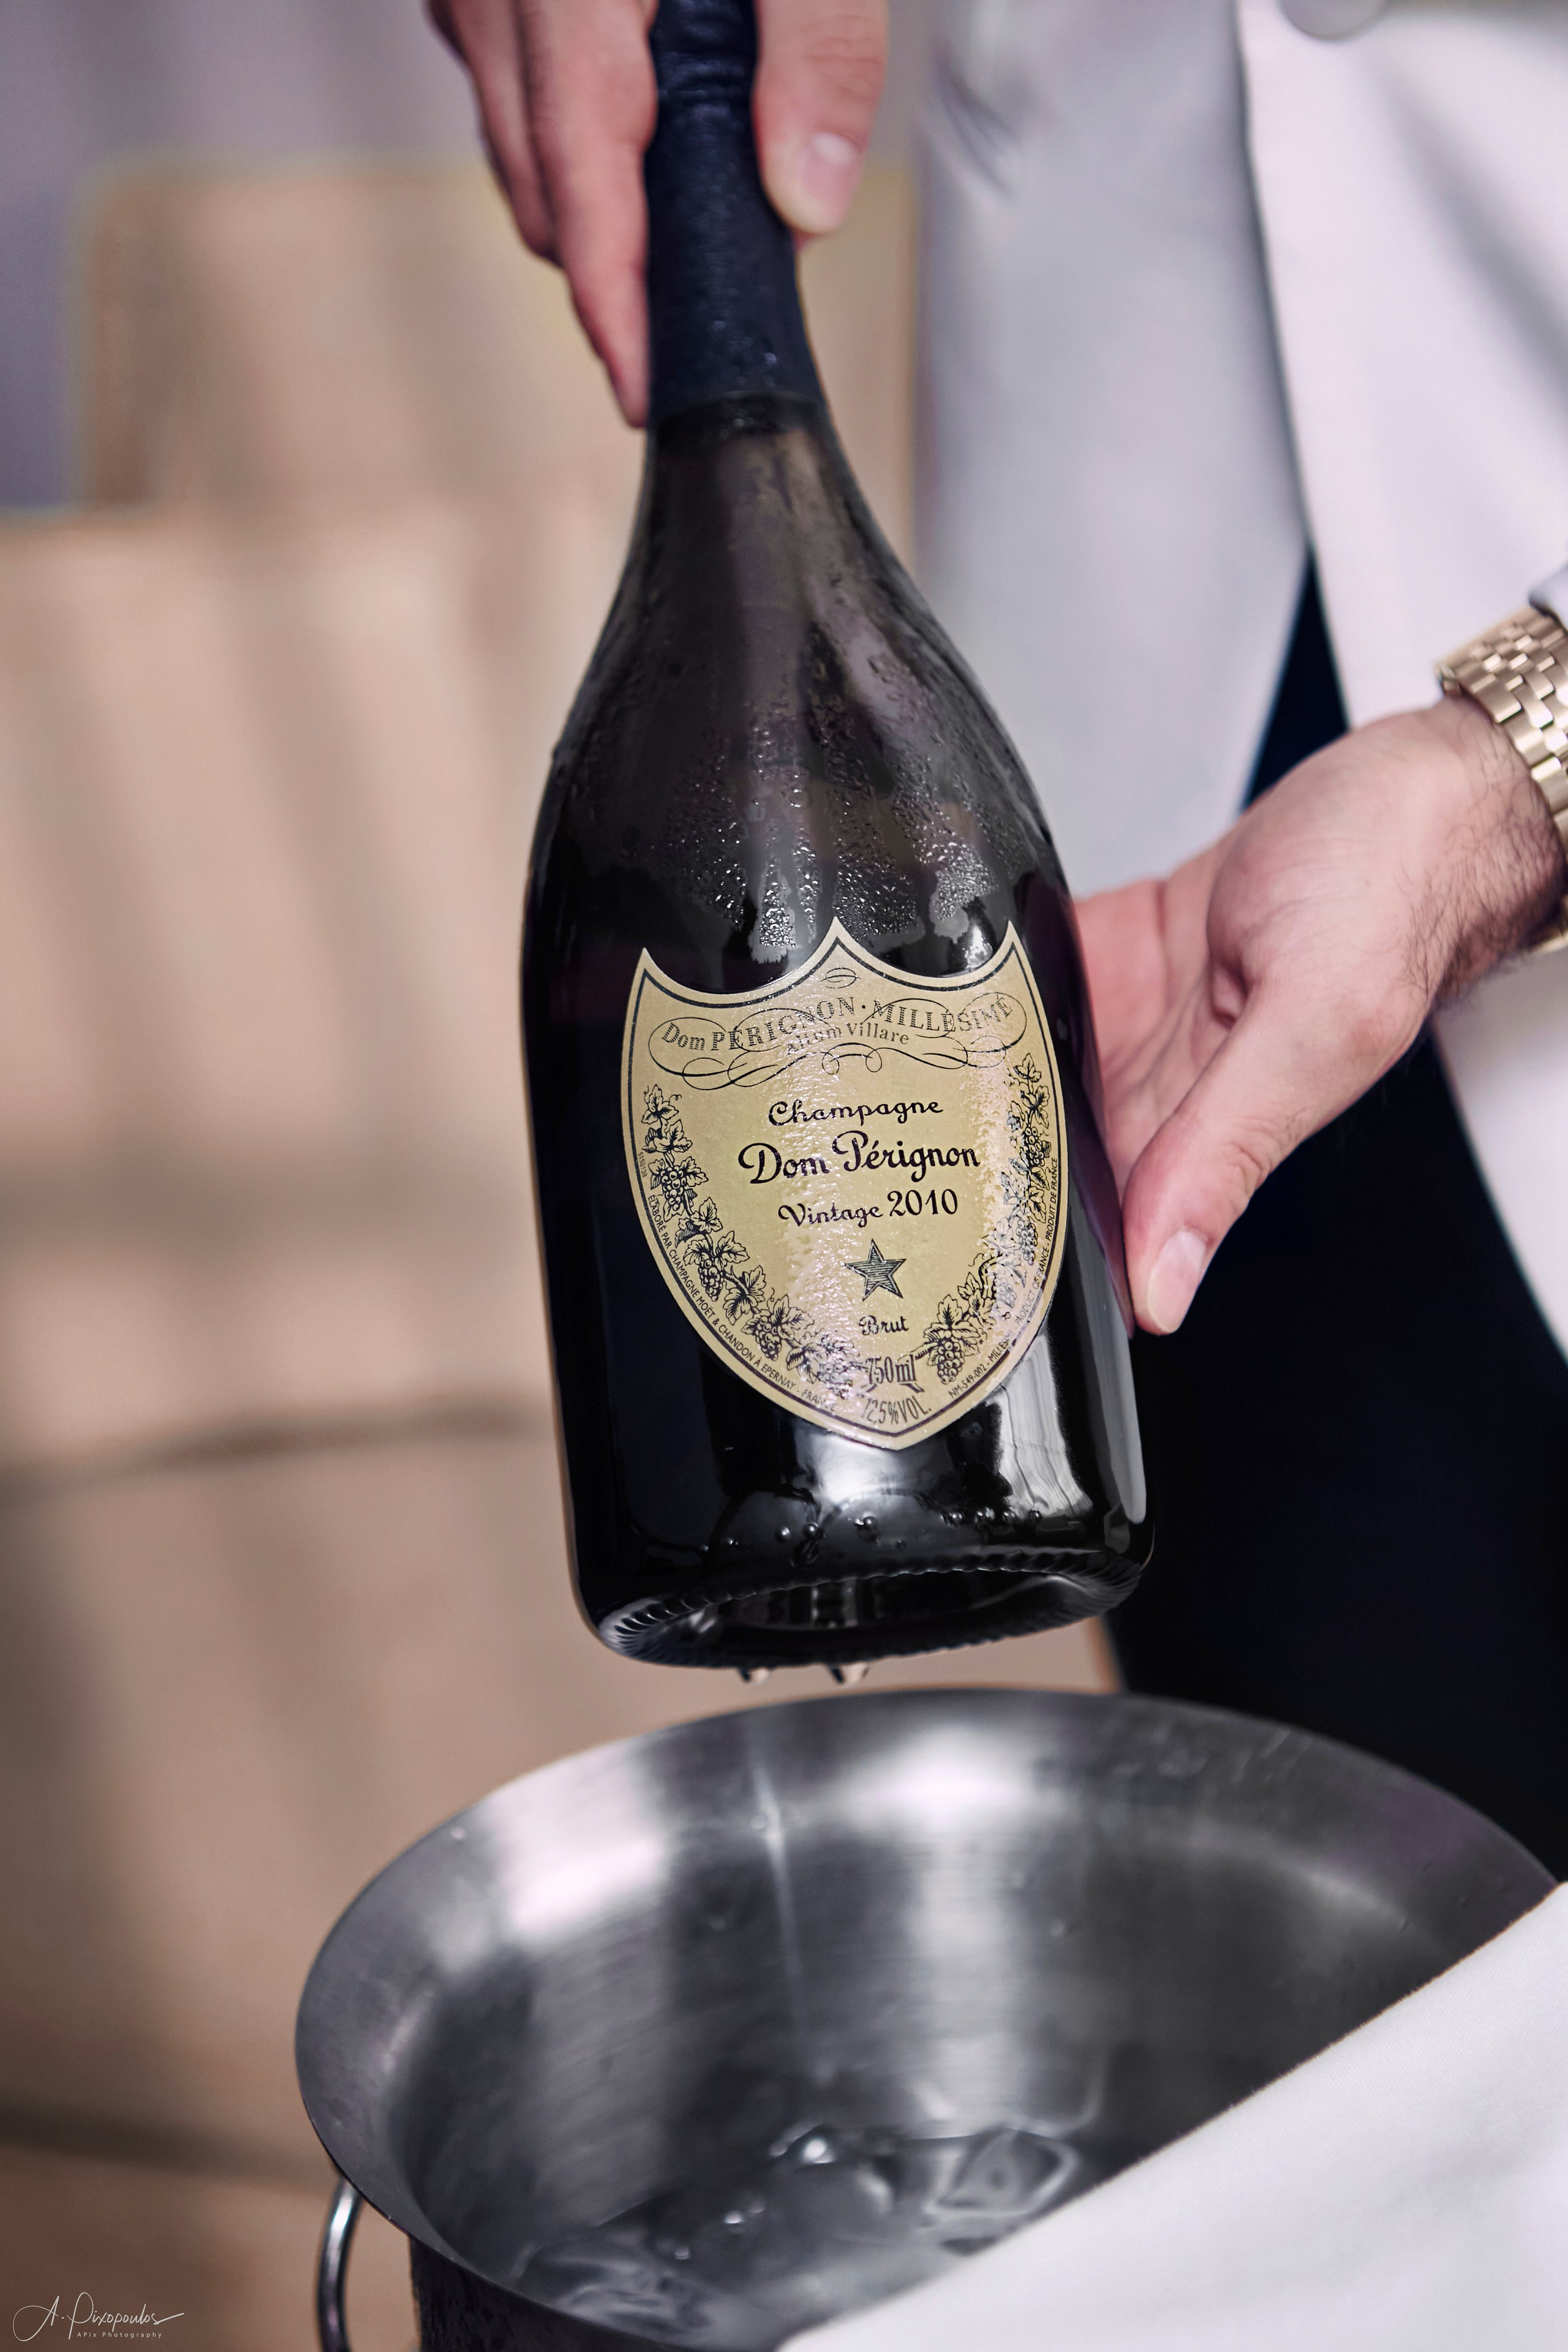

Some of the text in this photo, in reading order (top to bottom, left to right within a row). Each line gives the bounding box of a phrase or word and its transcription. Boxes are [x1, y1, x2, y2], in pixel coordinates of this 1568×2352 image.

[662, 1022, 705, 1051] Dom
[846, 1022, 910, 1046] Villare
[768, 1099, 944, 1126] Champagne
[737, 1129, 981, 1184] Dom Pérignon
[777, 1188, 959, 1228] Vintage 2010
[1050, 1191, 1058, 1204] DE
[1047, 1207, 1056, 1242] PRODUIT
[1036, 1247, 1050, 1277] FRANCE
[1032, 1276, 1041, 1290] OF
[648, 1194, 668, 1233] ÉLABORÉ
[661, 1233, 674, 1250] PAR
[669, 1248, 700, 1298] CHAMPAGNE
[696, 1295, 716, 1319] MOËT
[712, 1317, 720, 1327] &
[718, 1324, 755, 1362] CHANDON
[761, 1363, 796, 1390] EPERNAY
[801, 1389, 837, 1412] FRANE
[1015, 1291, 1036, 1327] PRODUCT
[858, 1315, 910, 1336] Brut
[865, 1354, 918, 1385] 750ml
[948, 1363, 987, 1398] NM-549-002
